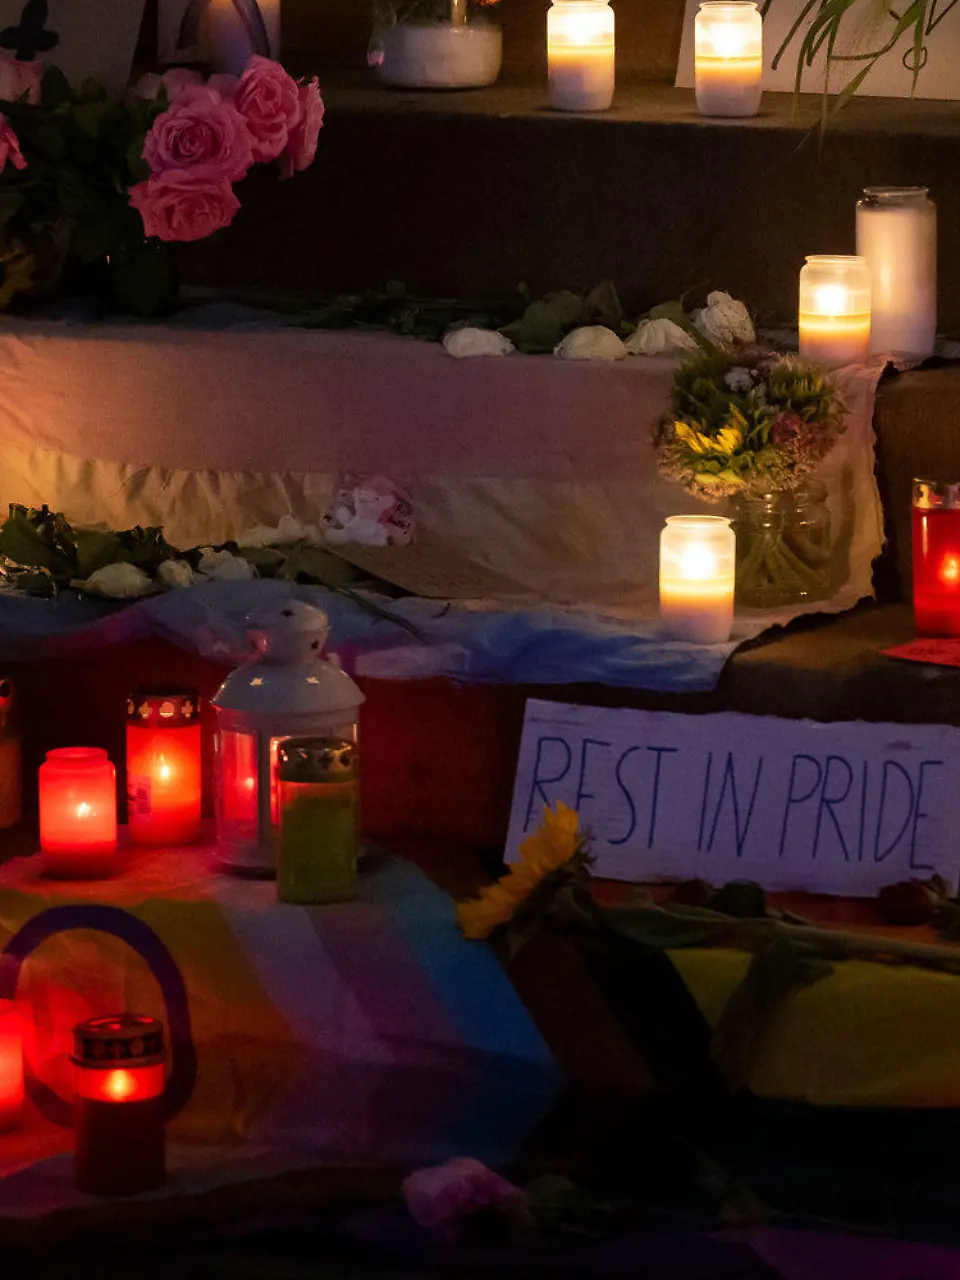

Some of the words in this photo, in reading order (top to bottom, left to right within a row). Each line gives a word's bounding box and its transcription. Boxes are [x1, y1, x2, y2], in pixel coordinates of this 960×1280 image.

[522, 736, 678, 849] REST
[697, 752, 764, 858] IN
[779, 754, 944, 870] PRIDE
